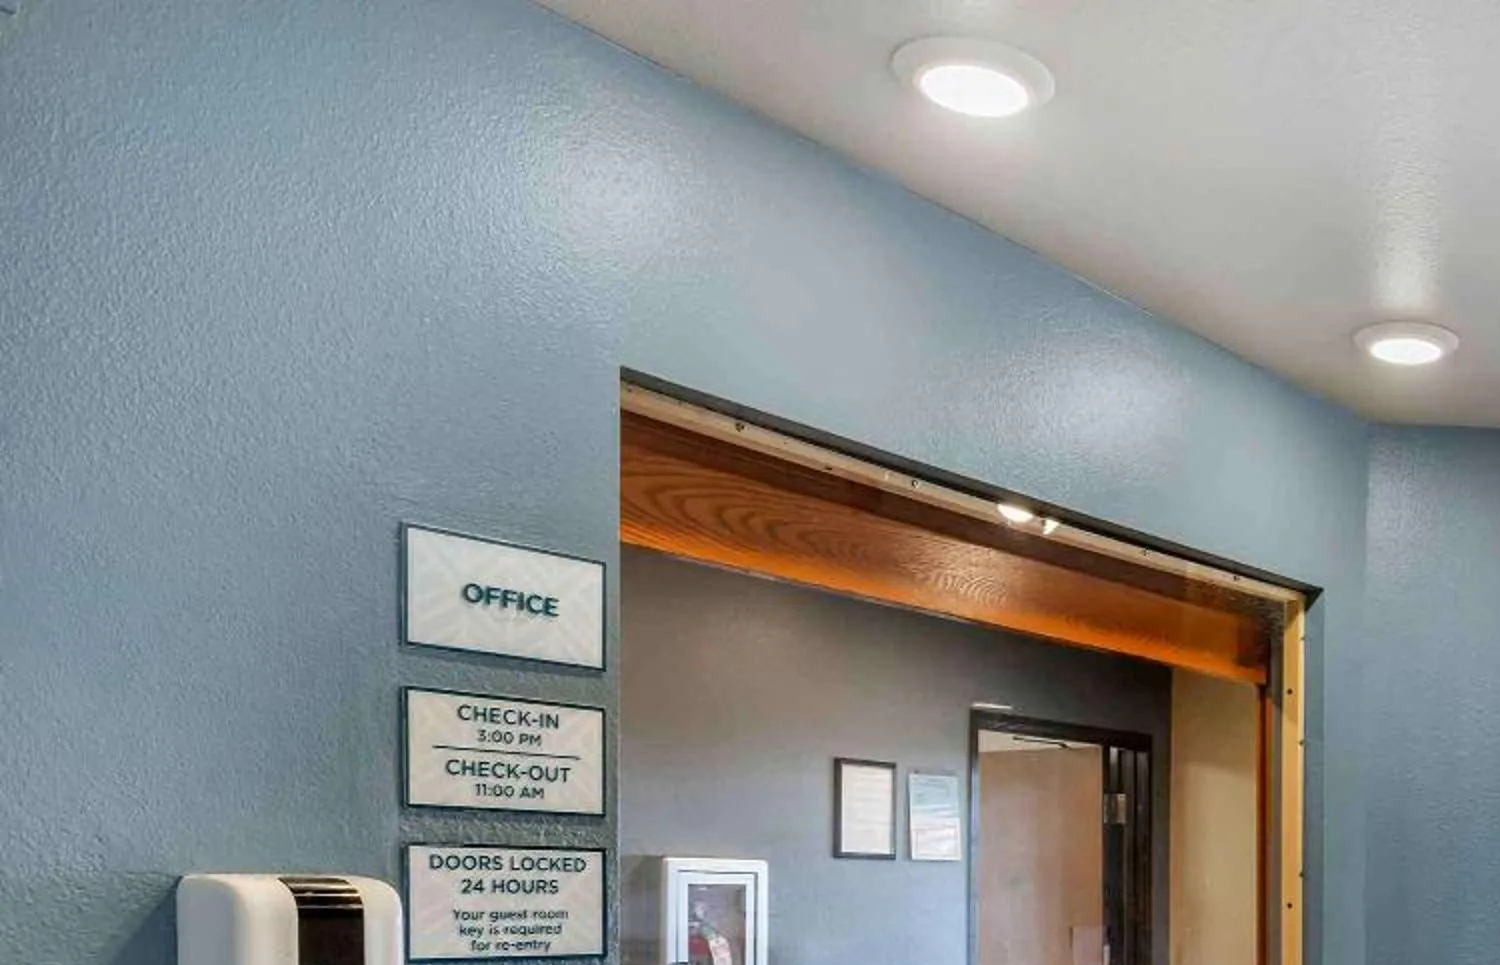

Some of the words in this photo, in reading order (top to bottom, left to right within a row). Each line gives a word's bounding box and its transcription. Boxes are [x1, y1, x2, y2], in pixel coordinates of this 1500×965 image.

[462, 583, 560, 617] OFFICE
[458, 704, 560, 729] CHECK-IN
[477, 729, 515, 744] 3:00
[519, 733, 542, 746] PM
[445, 759, 571, 783] CHECK-OUT
[475, 783, 515, 798] 11:00
[519, 786, 545, 799] AM
[429, 854, 503, 871] DOORS
[510, 855, 587, 873] LOCKED
[461, 879, 485, 894] 24
[492, 879, 560, 895] HOURS
[452, 909, 485, 921] Your
[489, 909, 528, 923] guest
[531, 910, 569, 920] room
[459, 924, 485, 938] key
[489, 923, 500, 935] is
[504, 923, 562, 938] required
[471, 939, 491, 951] for
[495, 940, 552, 953] re-entry
